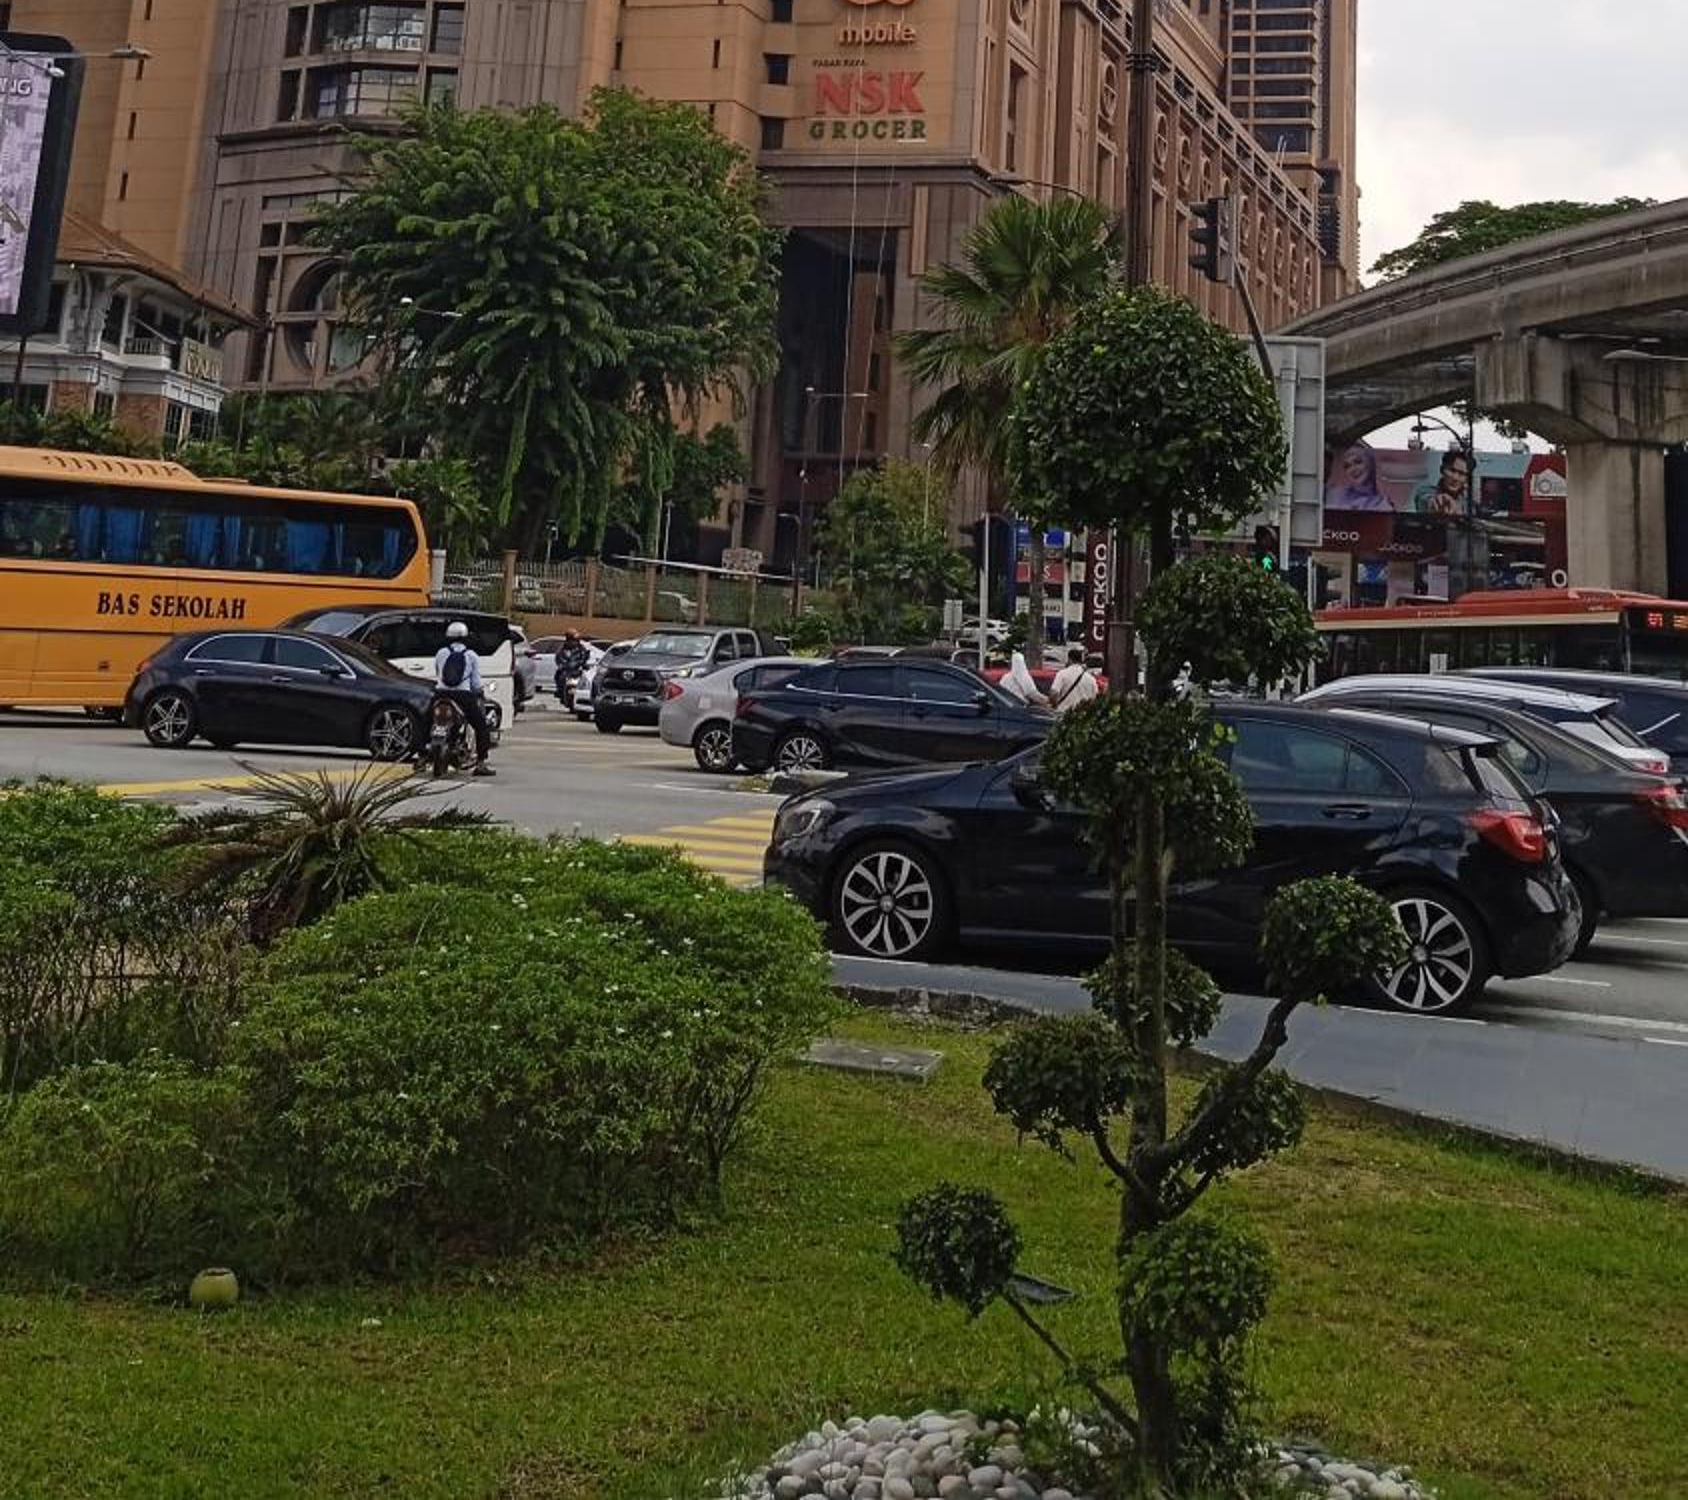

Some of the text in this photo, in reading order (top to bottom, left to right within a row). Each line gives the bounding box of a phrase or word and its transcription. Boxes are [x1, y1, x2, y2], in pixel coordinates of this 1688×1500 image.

[839, 21, 917, 45] mobile
[814, 70, 926, 115] NSK
[809, 119, 927, 140] GROCER
[96, 592, 247, 620] BAS SEKOLAH
[1093, 542, 1108, 642] CUCKOO
